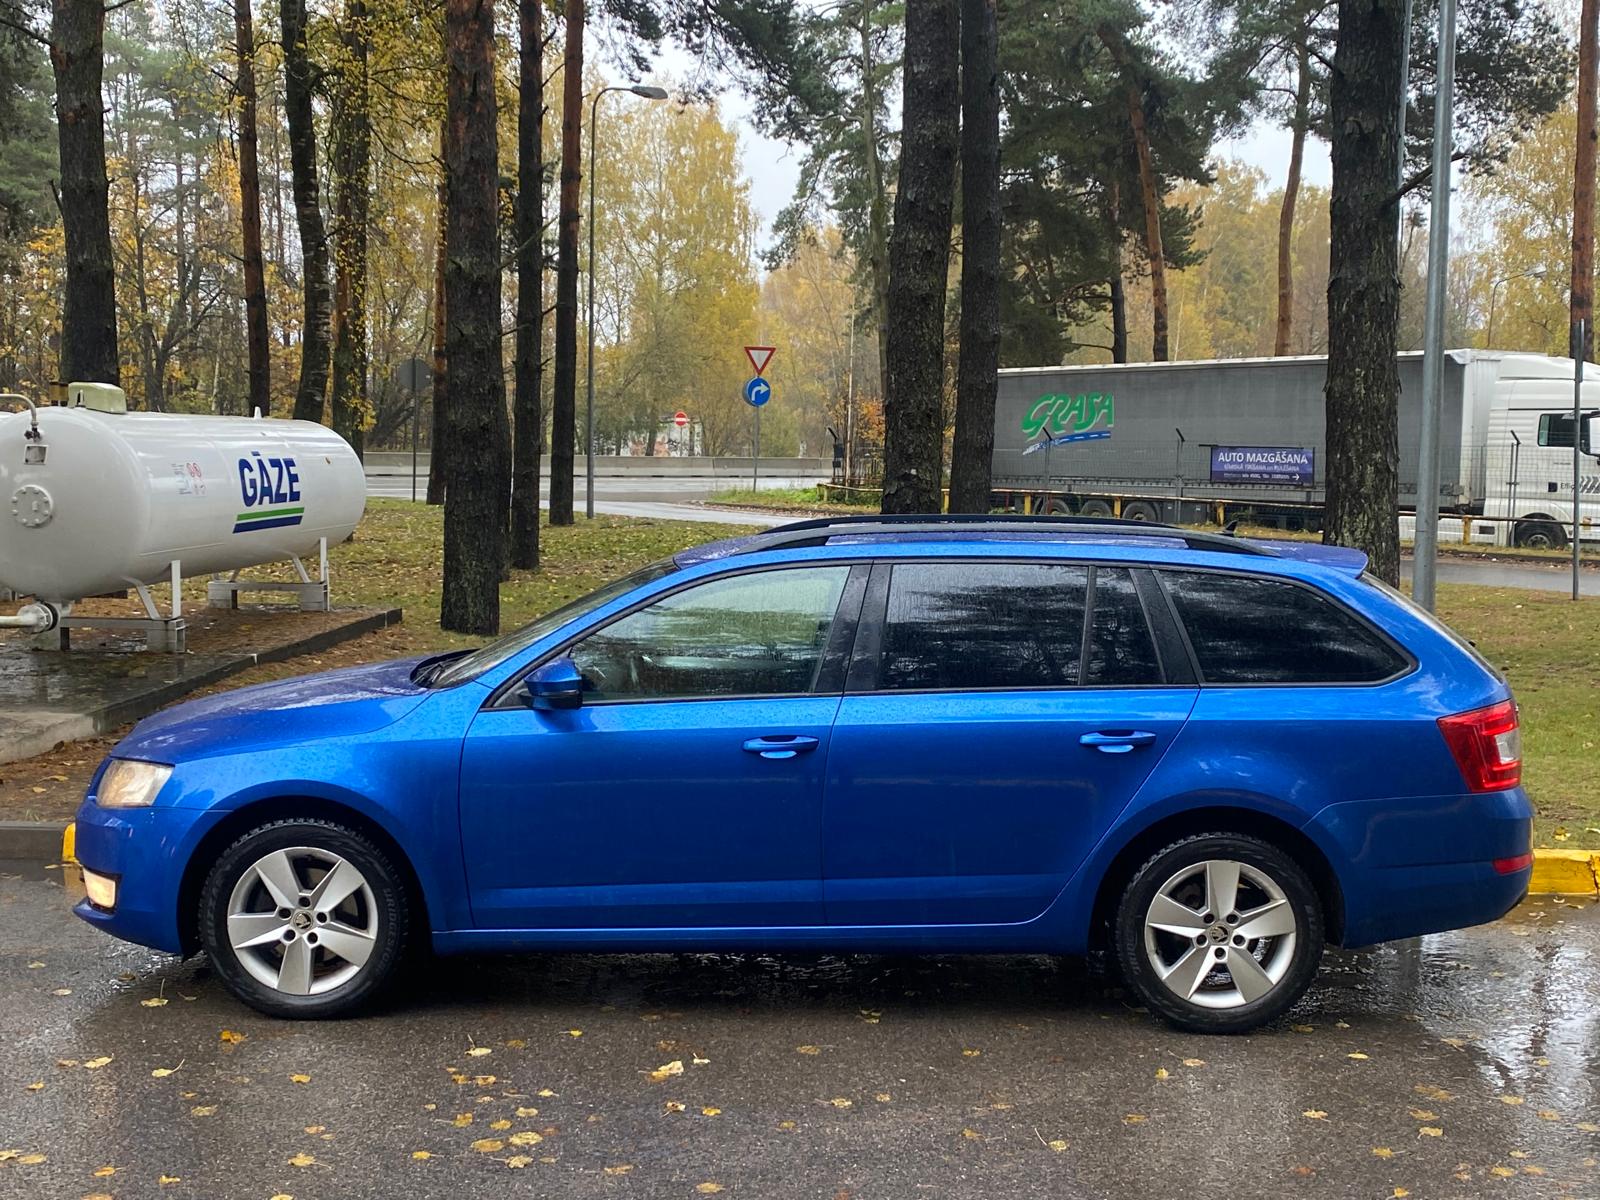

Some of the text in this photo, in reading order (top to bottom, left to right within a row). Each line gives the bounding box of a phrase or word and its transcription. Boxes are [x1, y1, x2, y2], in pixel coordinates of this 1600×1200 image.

[1021, 392, 1115, 442] GRASA
[238, 451, 301, 507] GĀZE
[1218, 451, 1308, 464] AUTO MAZGĀŠANA
